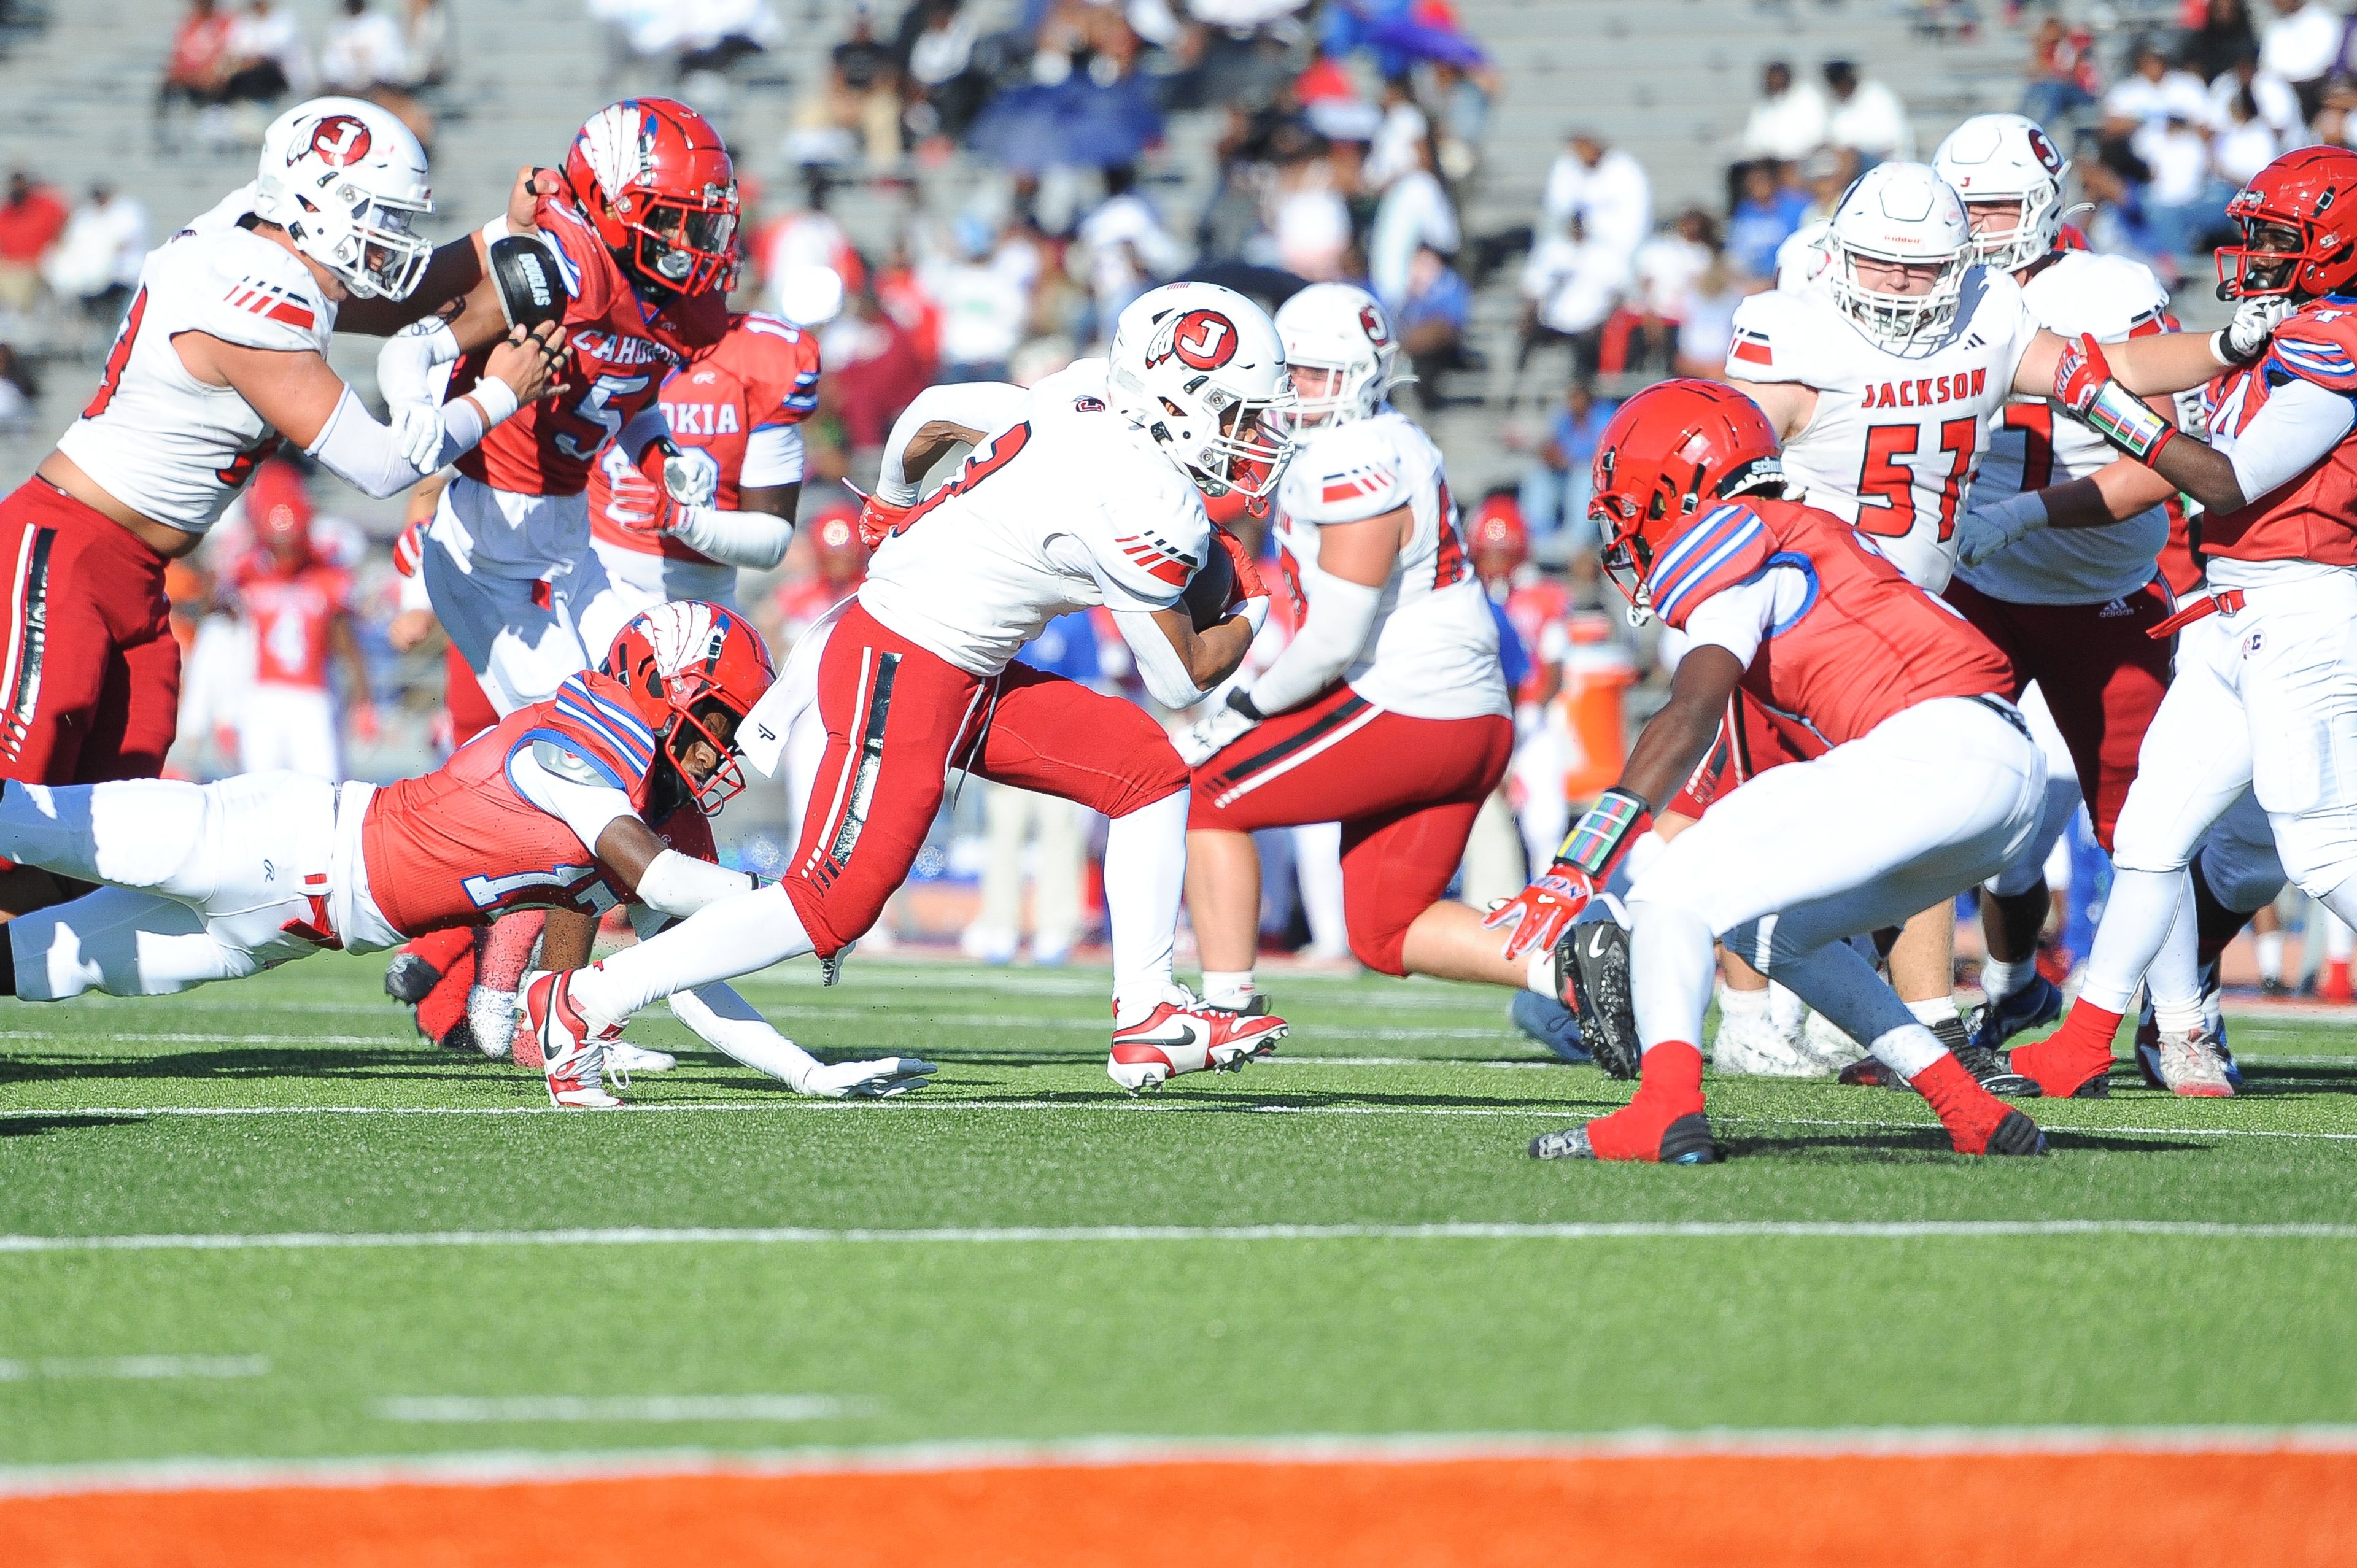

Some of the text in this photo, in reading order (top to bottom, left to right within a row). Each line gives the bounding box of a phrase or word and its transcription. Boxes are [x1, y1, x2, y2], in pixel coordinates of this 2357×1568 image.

[317, 121, 363, 154] J
[517, 253, 551, 306] DOUGLAS
[1179, 318, 1228, 358] J
[1861, 366, 1987, 408] JACKSON
[555, 374, 651, 462] 5
